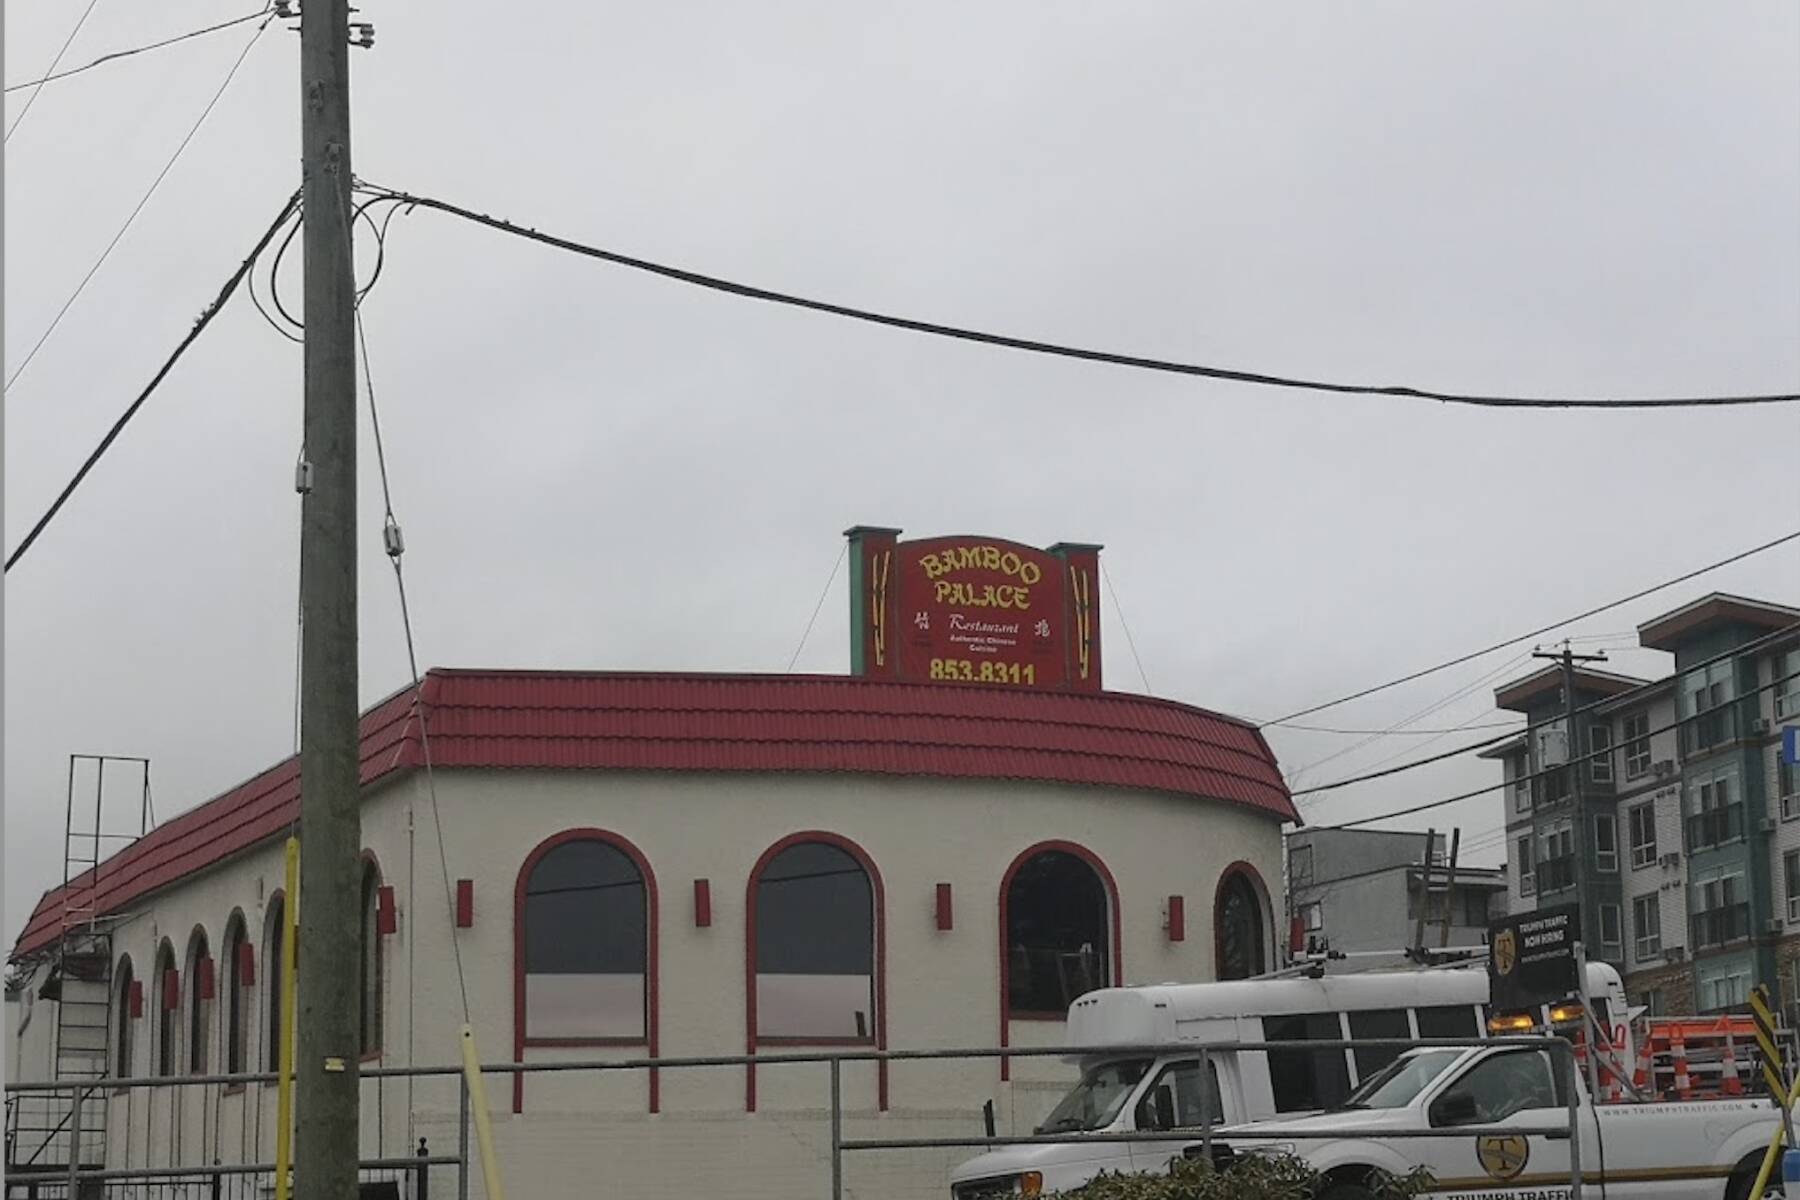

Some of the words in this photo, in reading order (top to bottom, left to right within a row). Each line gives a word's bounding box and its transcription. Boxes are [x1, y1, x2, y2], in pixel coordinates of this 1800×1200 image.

[919, 546, 1041, 584] BAMBOO
[934, 581, 1030, 609] PALACE
[949, 614, 1019, 634] Restaurant
